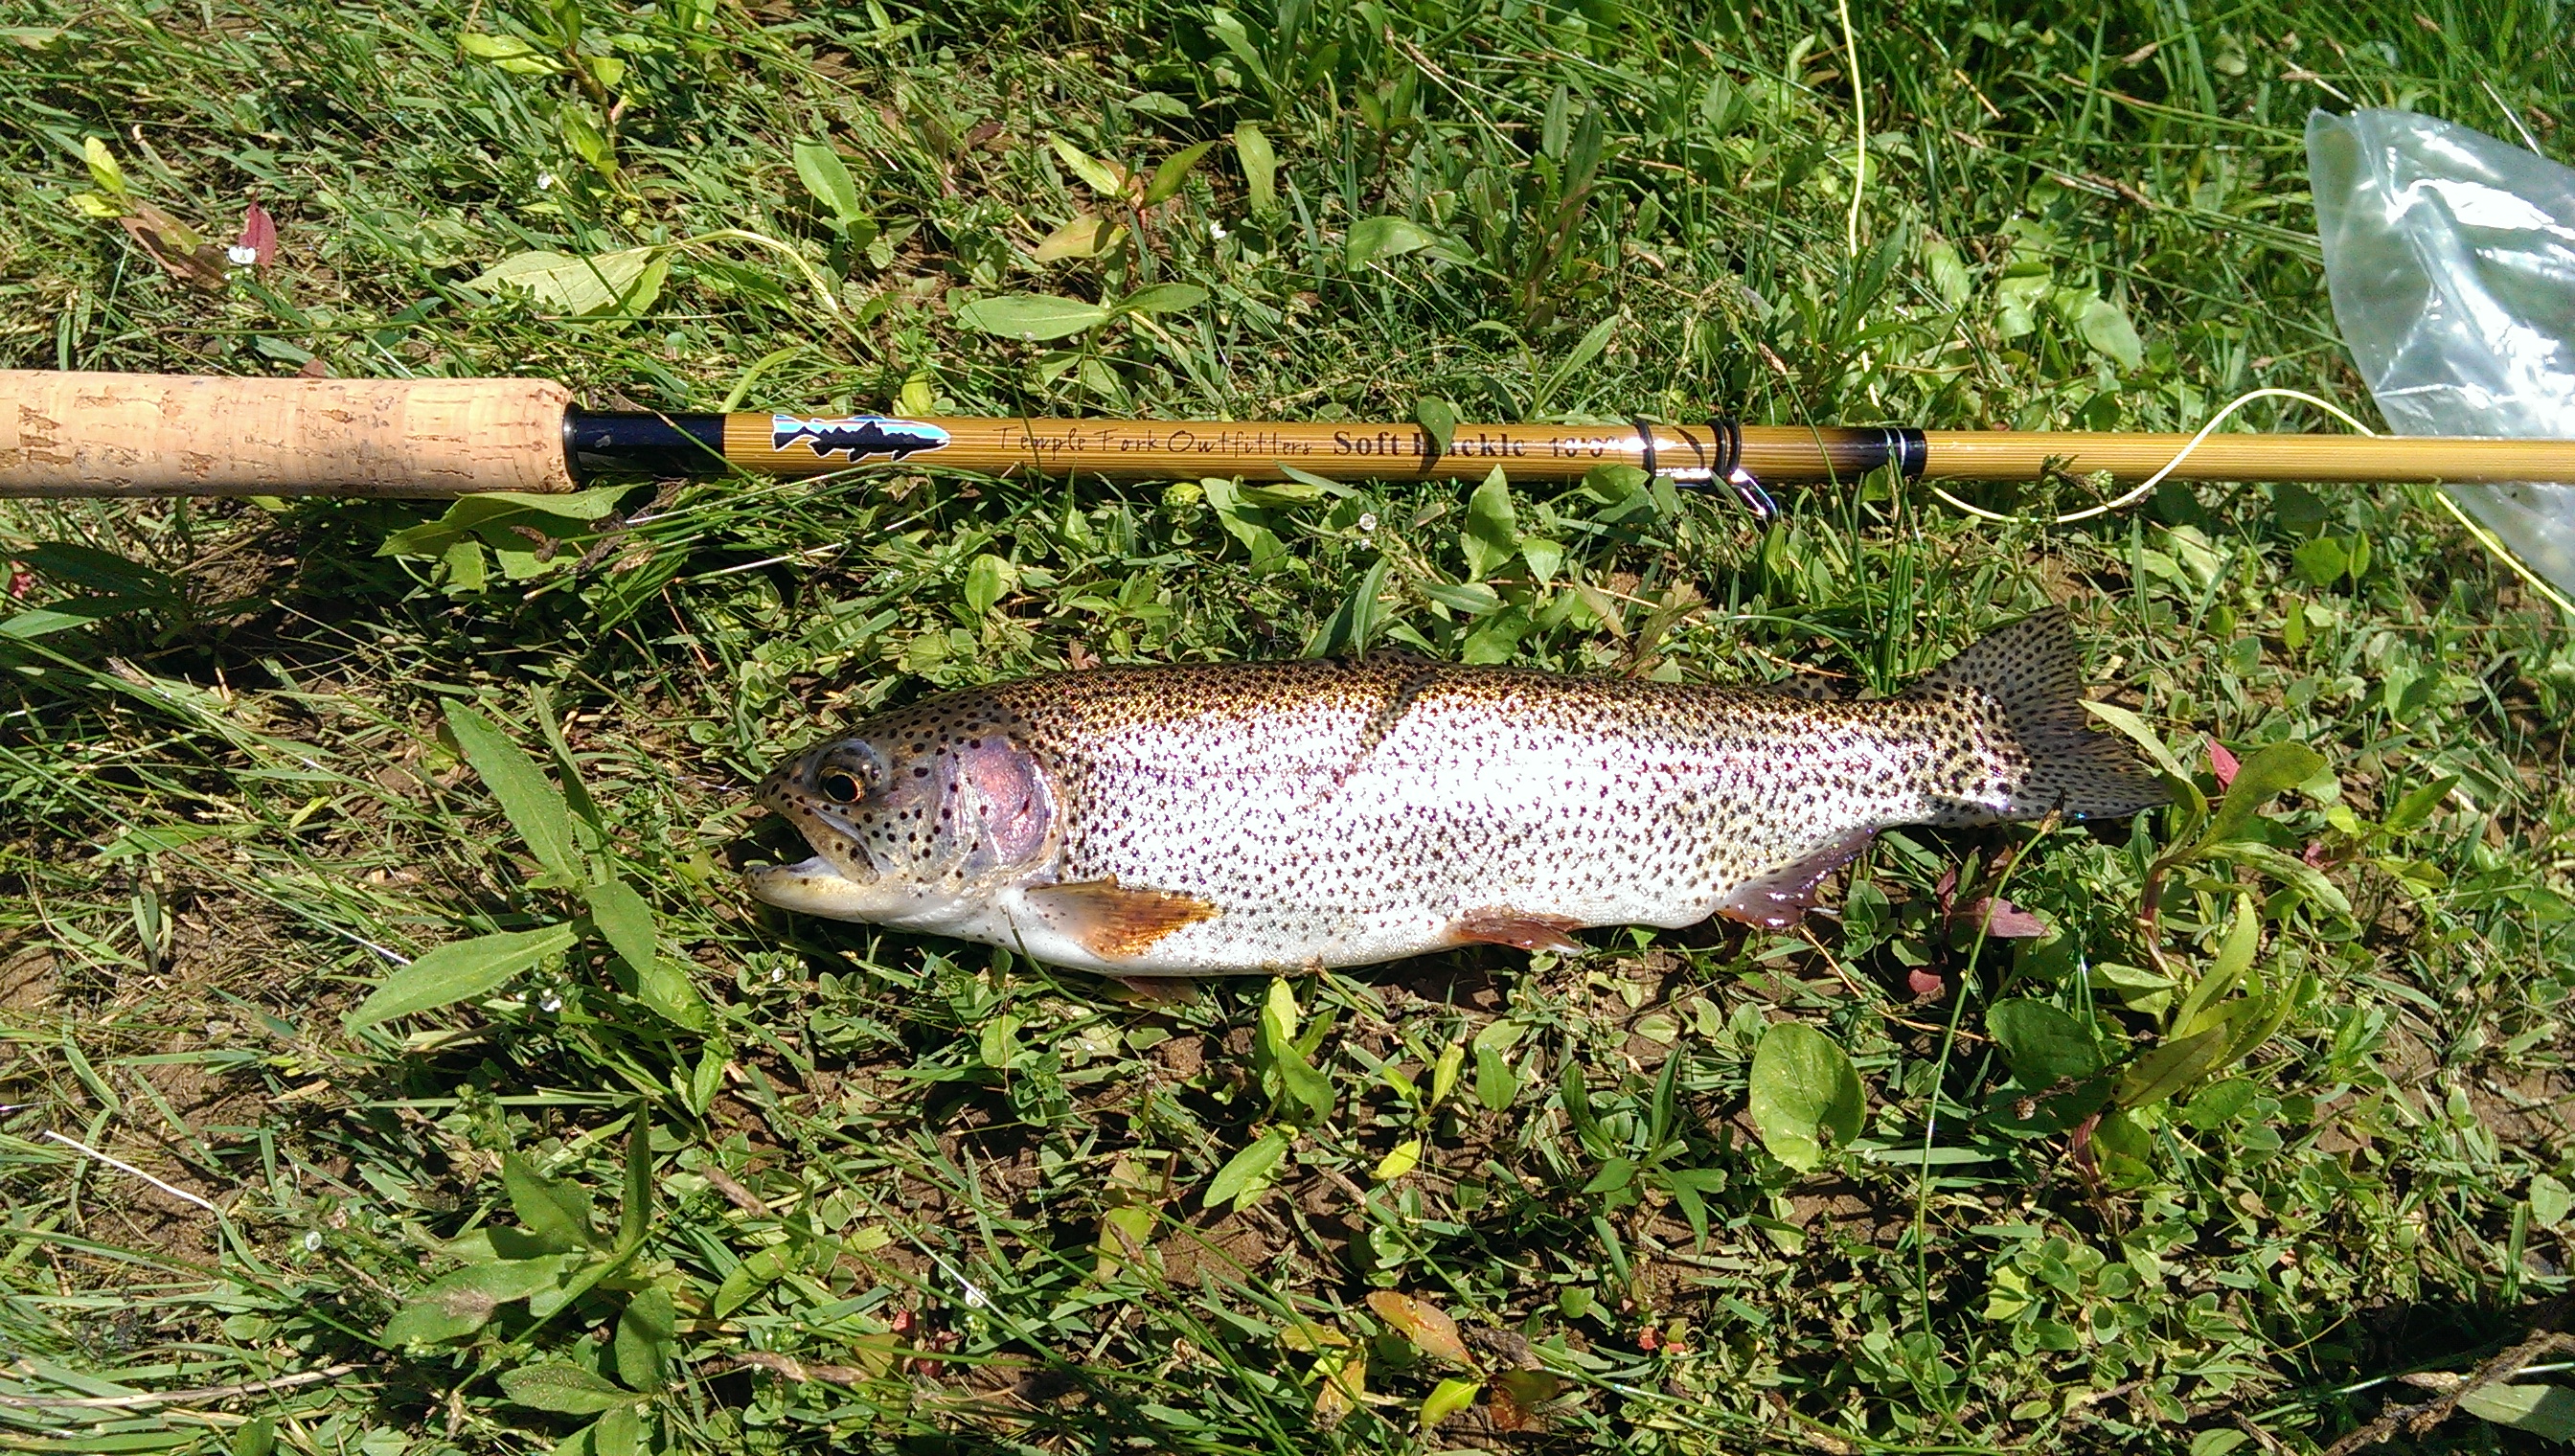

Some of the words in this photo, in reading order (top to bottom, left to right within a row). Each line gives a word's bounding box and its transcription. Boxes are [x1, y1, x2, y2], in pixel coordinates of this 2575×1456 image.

[992, 425, 1086, 461] Temple
[1094, 428, 1159, 455] Fork
[1167, 429, 1312, 459] Outfitters
[1333, 430, 1401, 457] Soft
